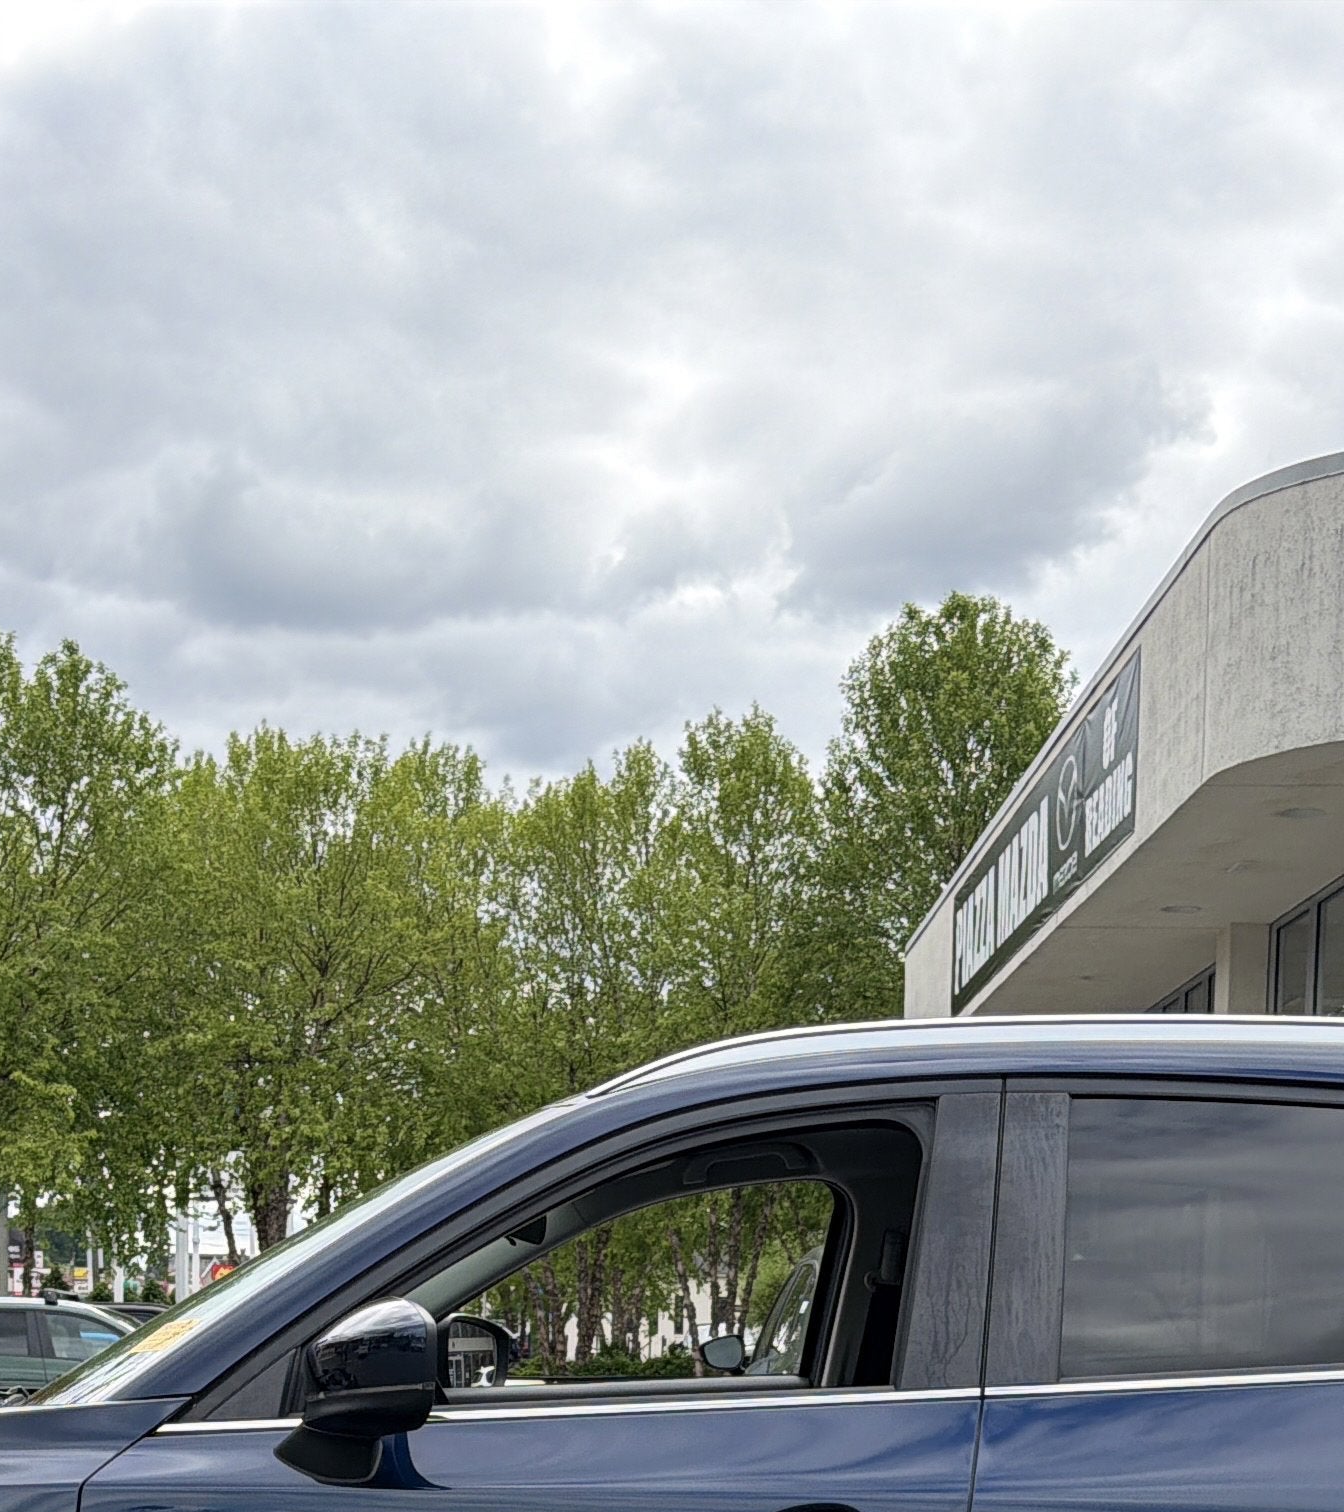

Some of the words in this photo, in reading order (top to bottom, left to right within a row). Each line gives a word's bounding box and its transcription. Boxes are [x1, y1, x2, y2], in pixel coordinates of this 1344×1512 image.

[1102, 697, 1119, 770] OF
[1084, 751, 1133, 859] READING
[954, 864, 996, 995] PIAZZA
[996, 794, 1049, 950] MAZDA
